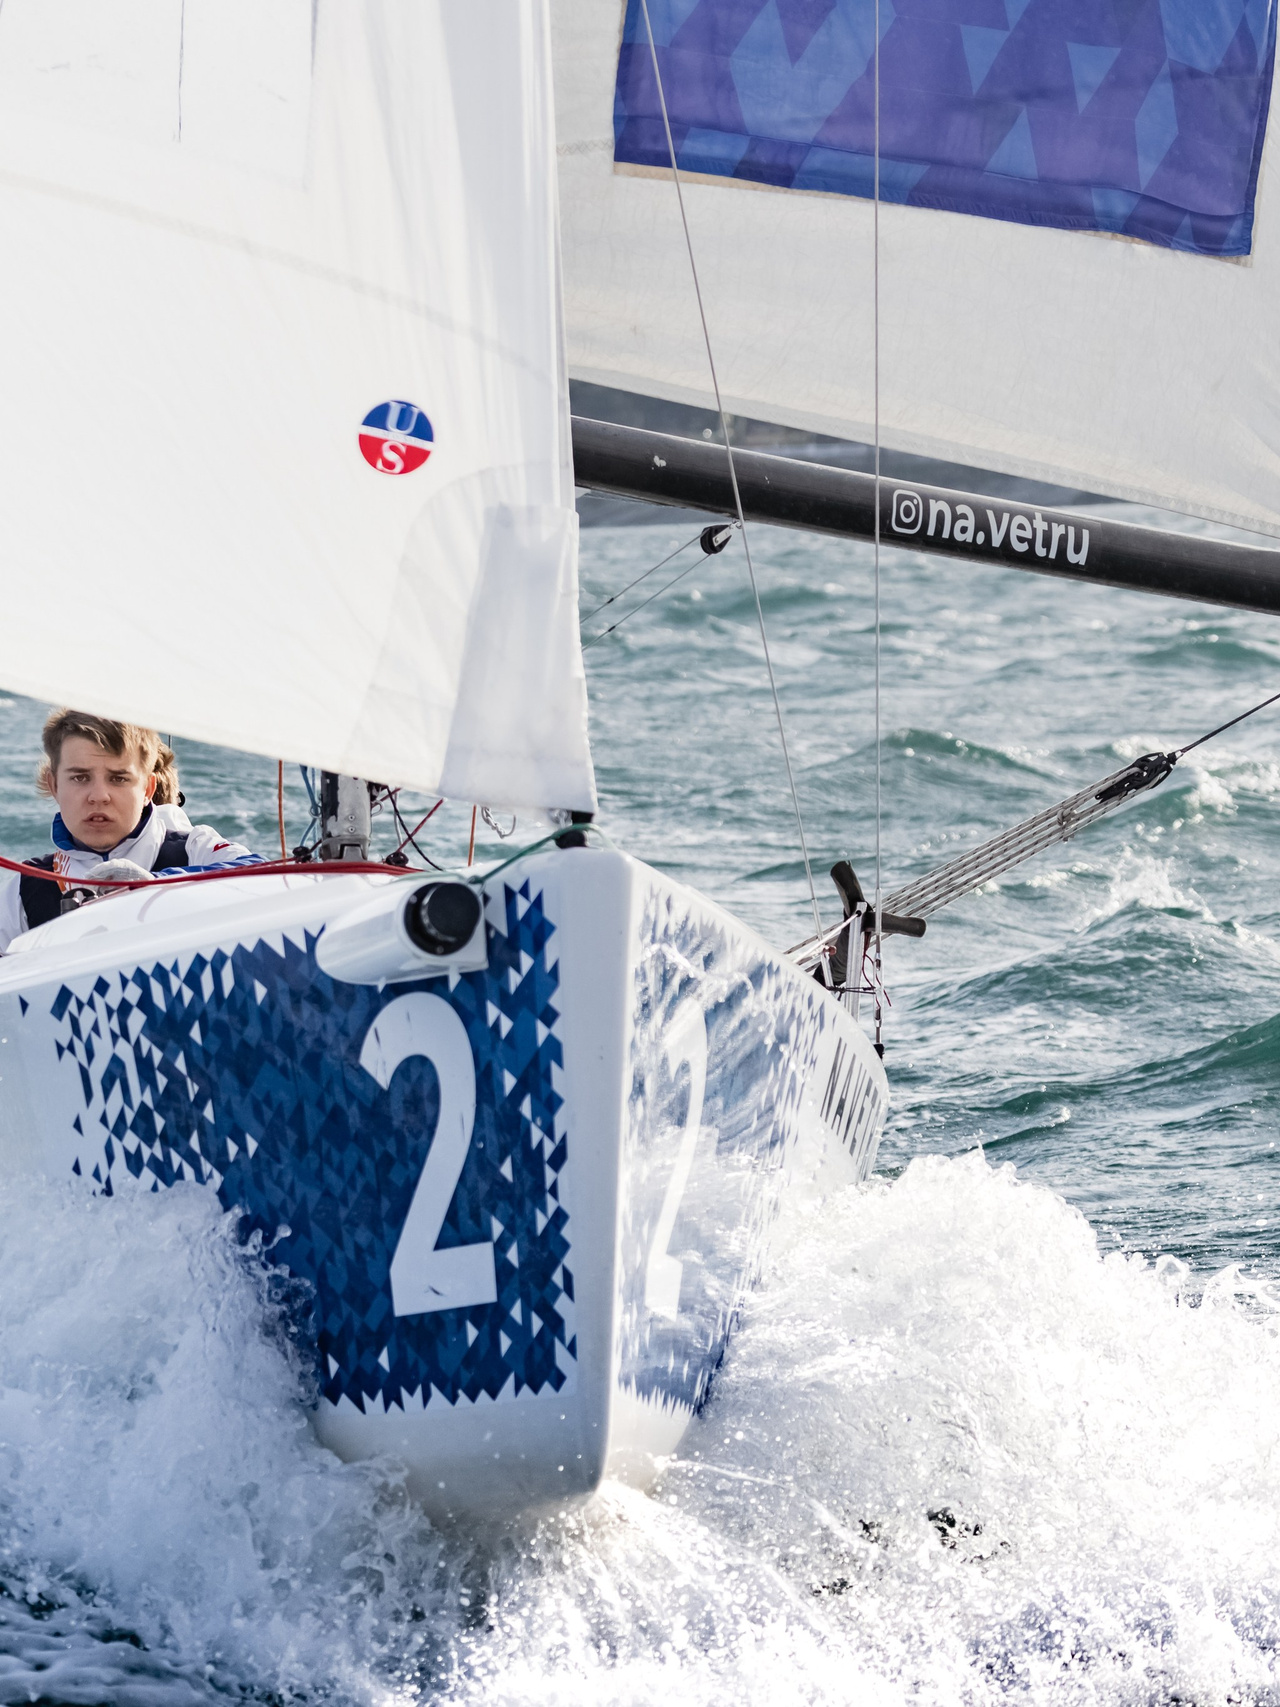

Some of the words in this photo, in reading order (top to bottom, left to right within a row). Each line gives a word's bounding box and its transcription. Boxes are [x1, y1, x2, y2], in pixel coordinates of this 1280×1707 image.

[926, 498, 1091, 566] na.vetru
[359, 991, 497, 1317] 2
[645, 998, 708, 1322] 2
